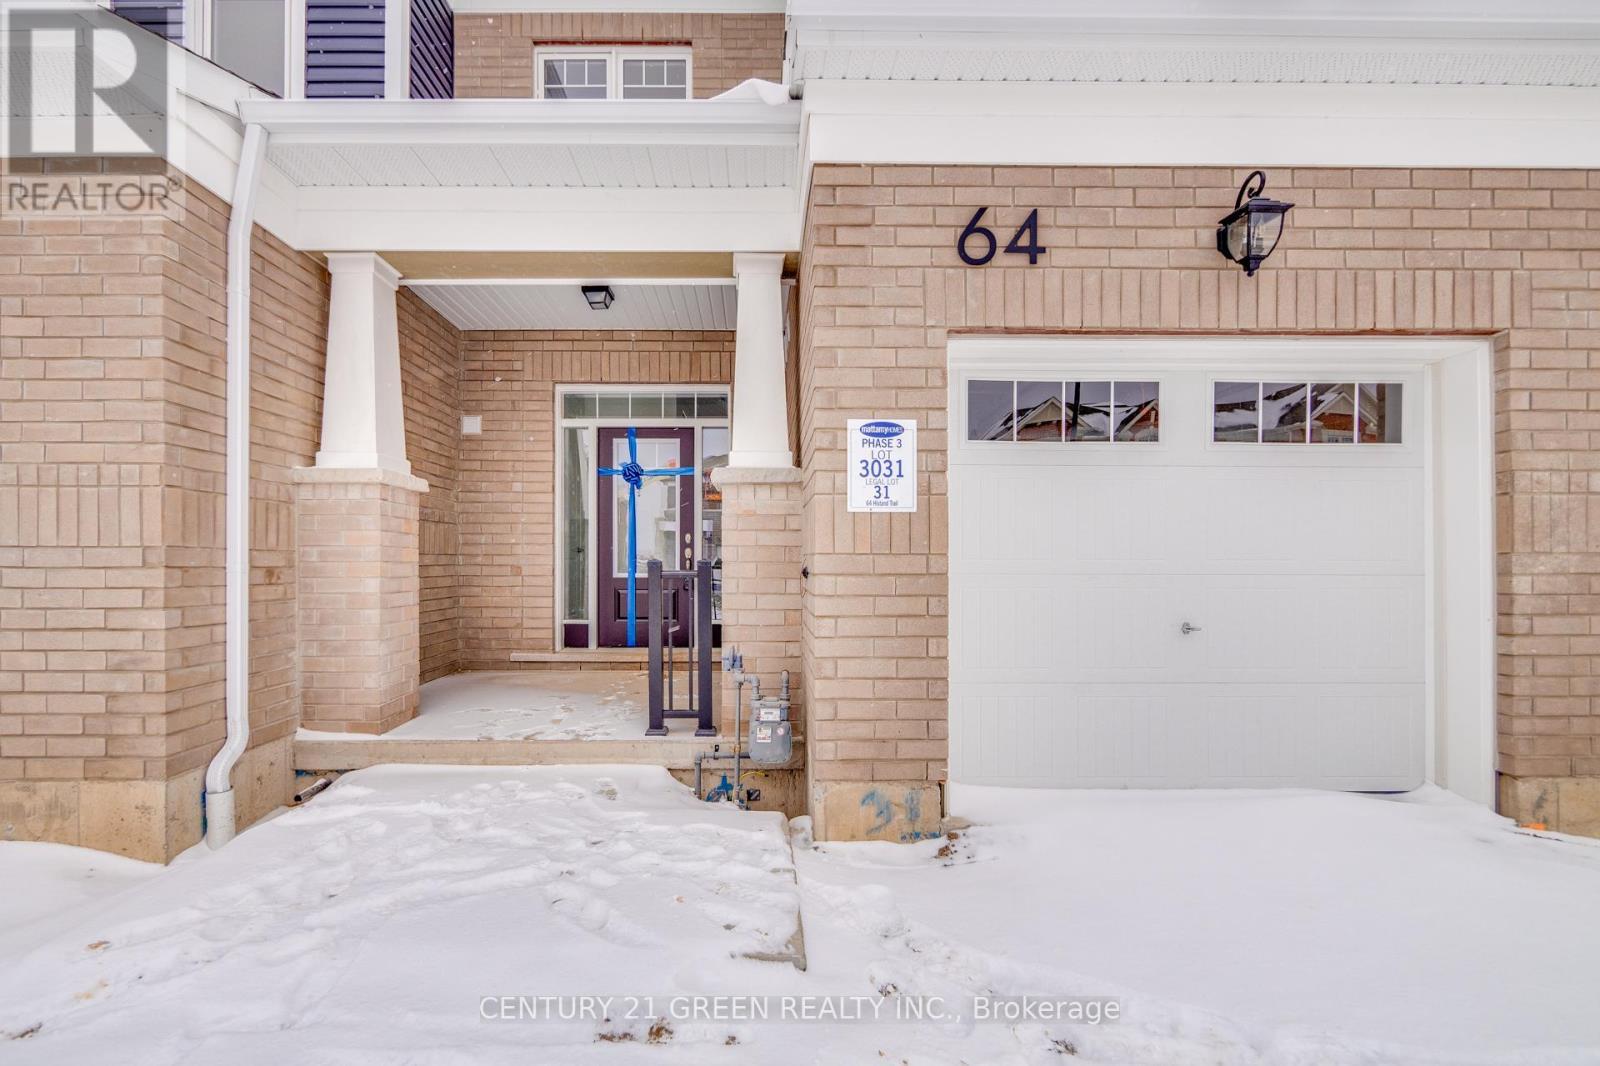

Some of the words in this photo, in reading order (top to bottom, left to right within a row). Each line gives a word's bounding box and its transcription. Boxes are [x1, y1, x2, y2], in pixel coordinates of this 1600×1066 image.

[957, 207, 1046, 266] 64
[861, 438, 893, 448] PHASE
[896, 438, 902, 448] 3
[871, 450, 892, 460] LOT
[859, 460, 904, 477] 3031
[873, 485, 890, 499] 31
